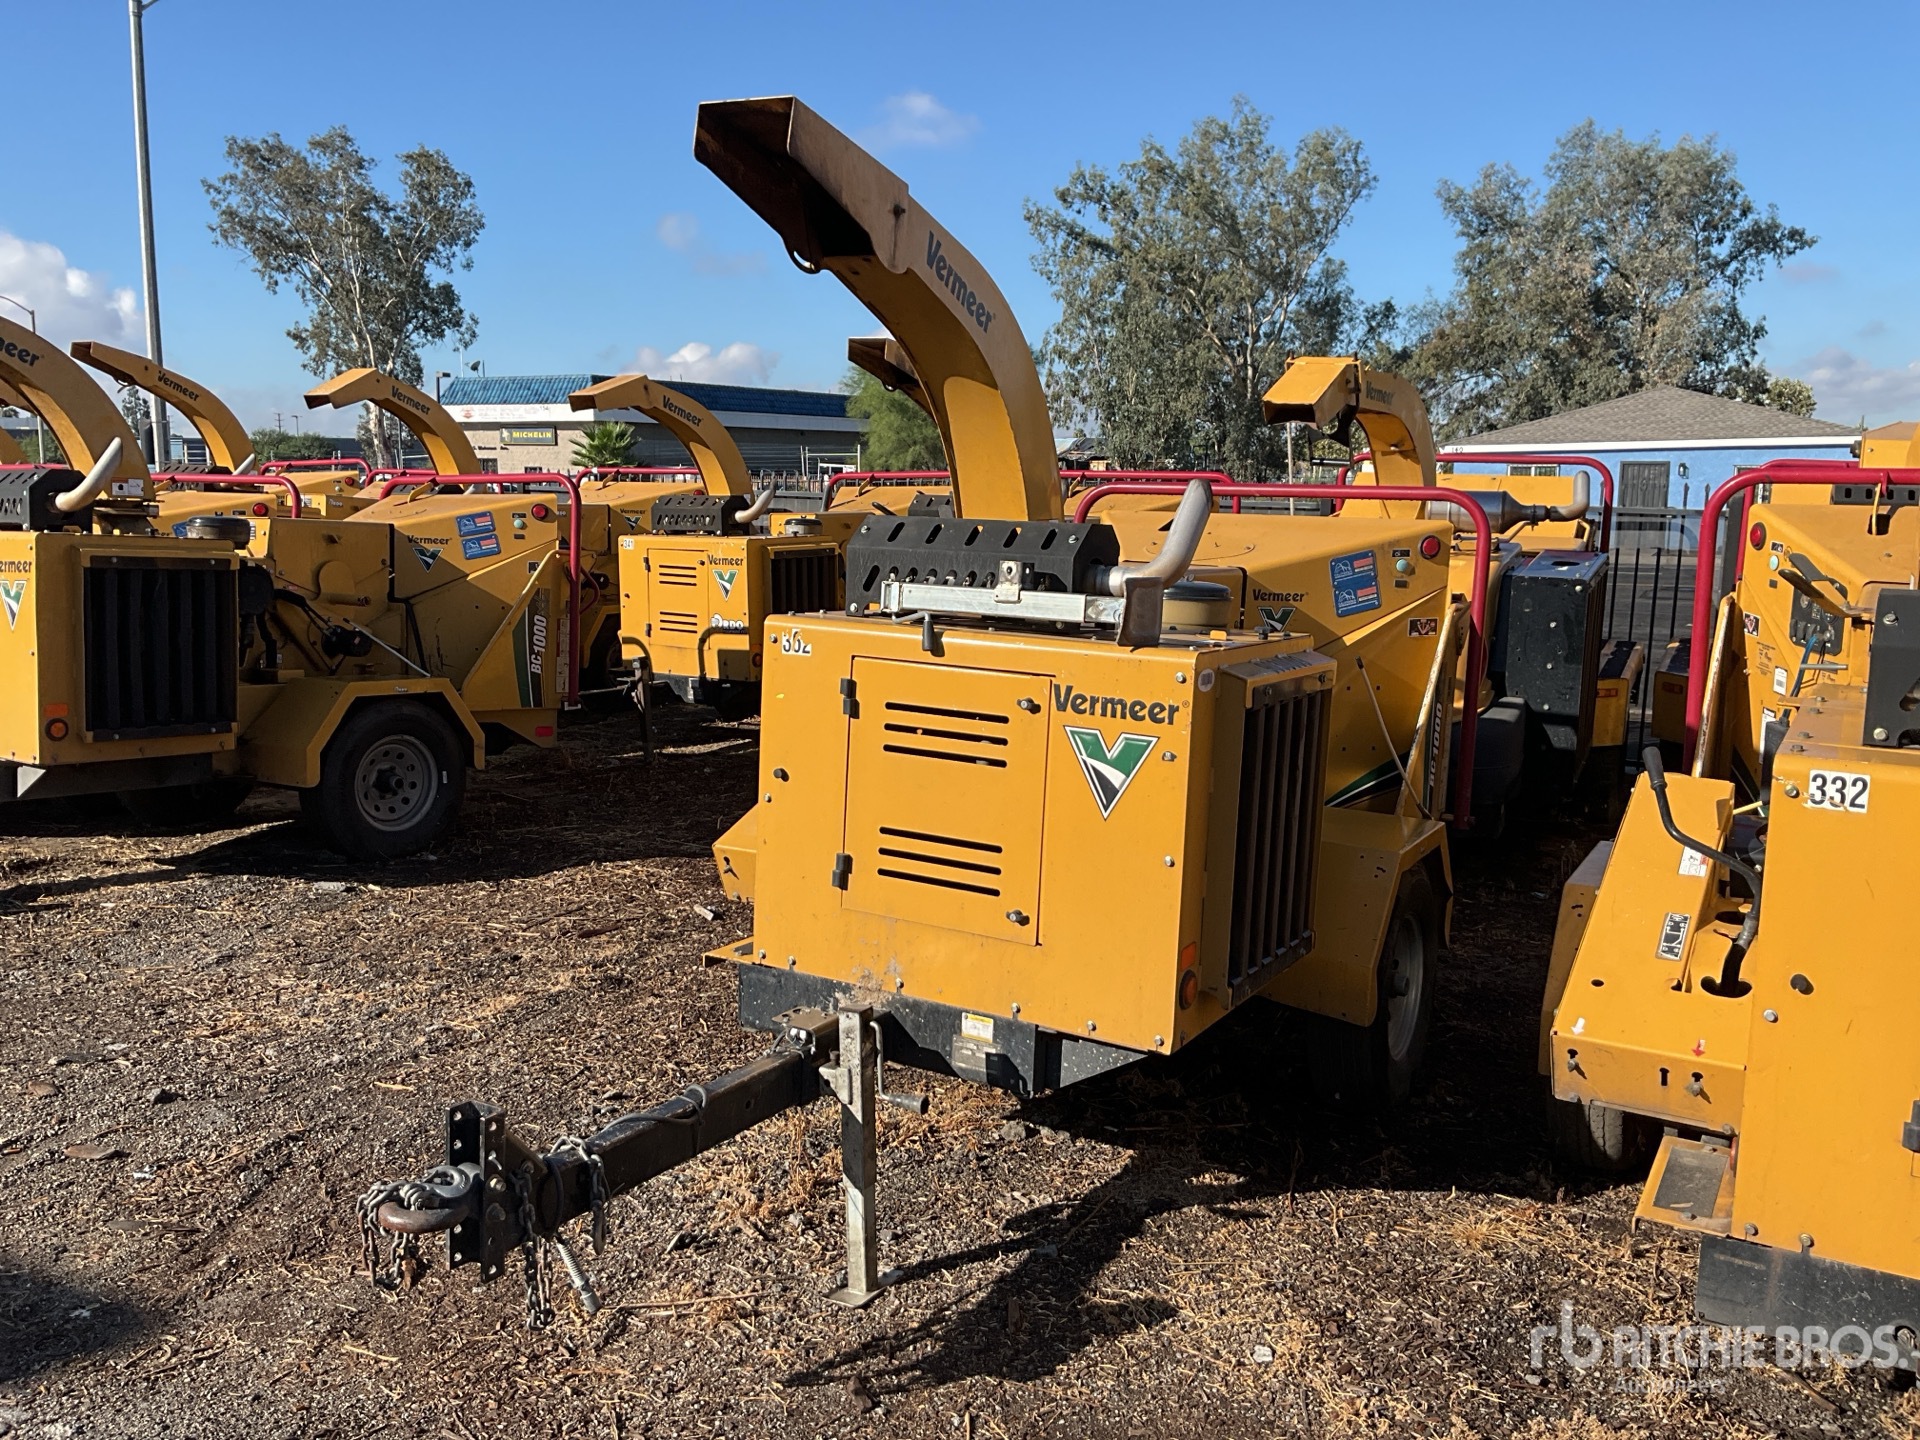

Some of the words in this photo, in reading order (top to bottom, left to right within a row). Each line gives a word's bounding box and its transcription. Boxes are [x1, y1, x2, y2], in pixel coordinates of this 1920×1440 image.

[926, 230, 992, 334] Vermeer
[158, 370, 200, 402] Vermeer
[391, 385, 431, 415] Vermeer
[1366, 380, 1395, 406] Vermeer
[663, 394, 702, 427] Vermeer
[407, 535, 451, 545] Vermeer
[0, 560, 32, 573] ermeer
[707, 554, 744, 567] Vermeer
[1252, 589, 1305, 602] Vermeer
[1053, 683, 1180, 725] Vermeer
[1809, 773, 1869, 809] 332
